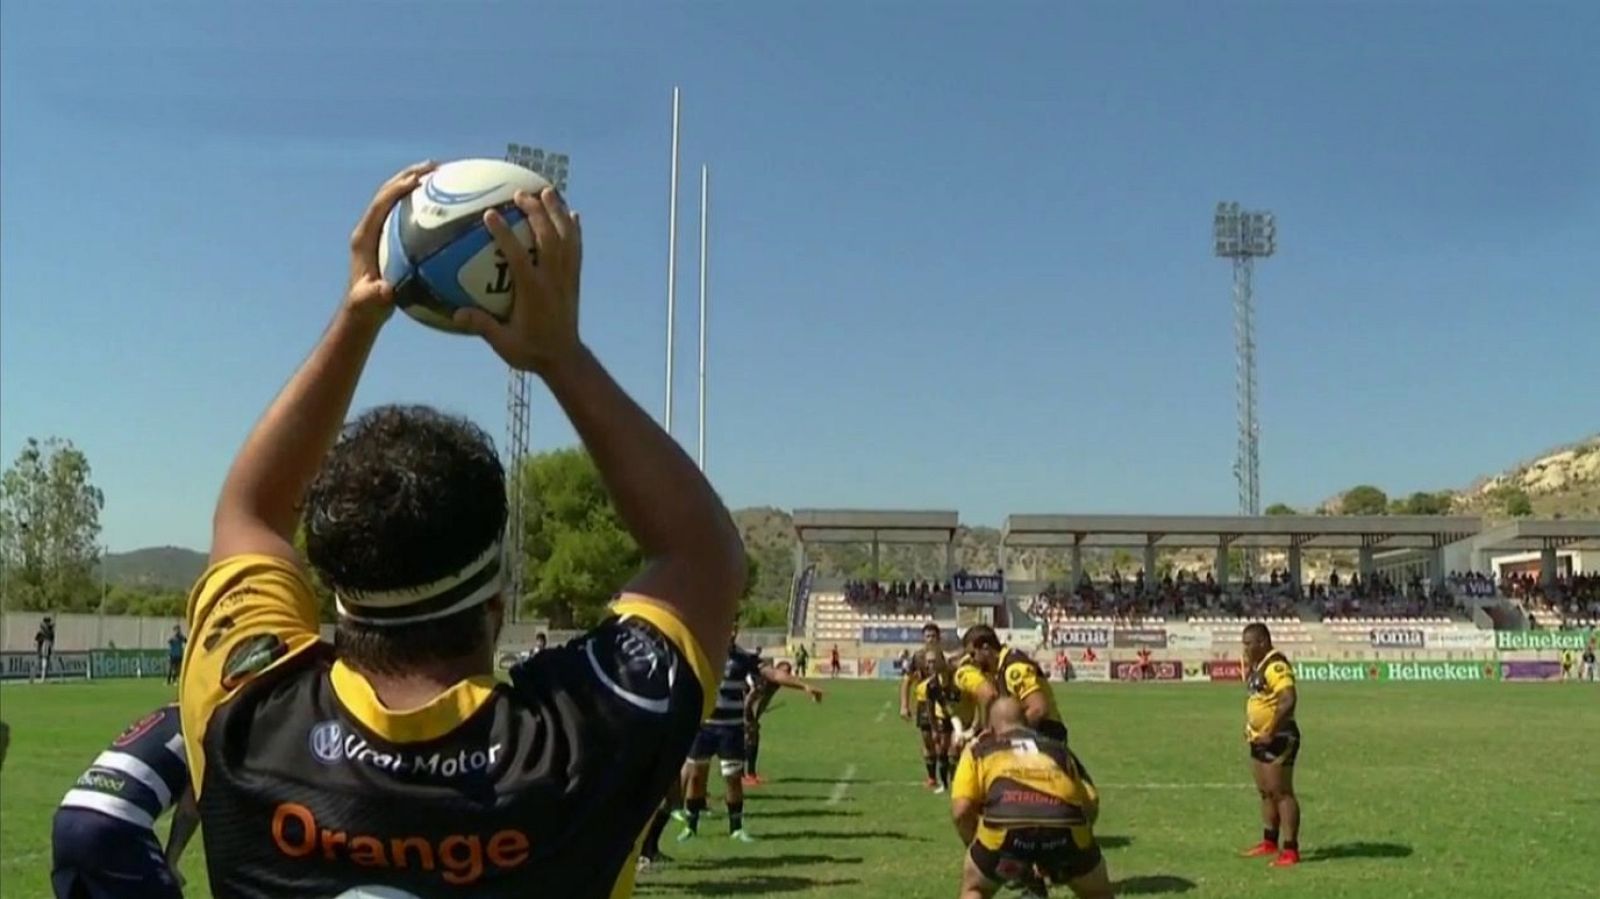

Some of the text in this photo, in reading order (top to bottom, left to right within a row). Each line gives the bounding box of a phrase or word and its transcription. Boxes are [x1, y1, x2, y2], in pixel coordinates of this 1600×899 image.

[975, 577, 999, 590] Vila
[1498, 632, 1585, 649] Heineken
[1387, 662, 1480, 680] Heineken
[412, 743, 501, 777] Motor
[271, 803, 530, 885] Orange
